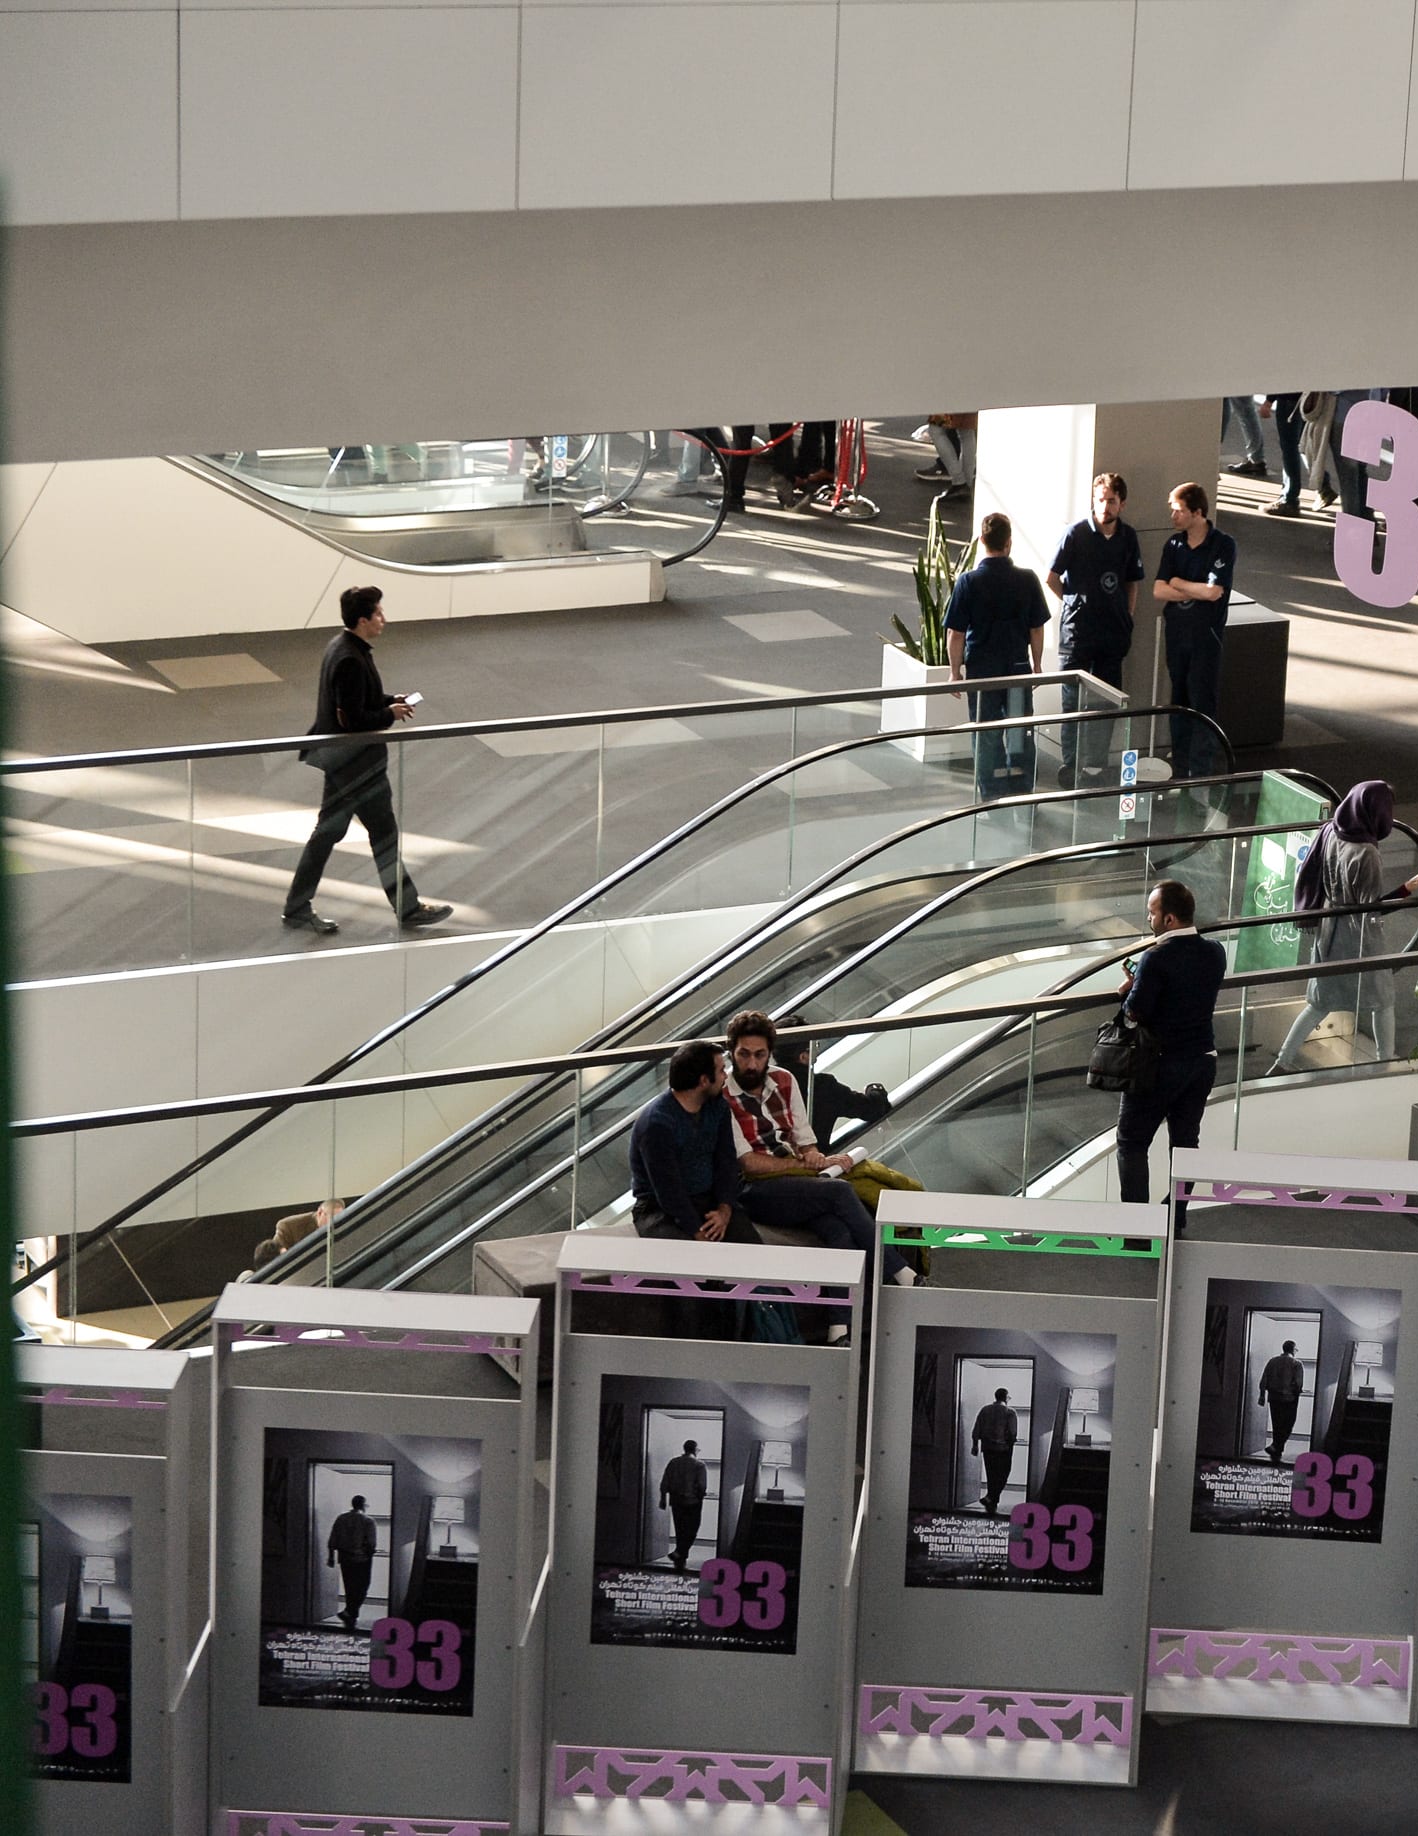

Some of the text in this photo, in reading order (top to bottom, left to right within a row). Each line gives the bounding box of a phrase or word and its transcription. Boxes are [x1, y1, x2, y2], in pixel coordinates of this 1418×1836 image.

[1205, 1481, 1292, 1494] Tehran International
[1292, 1452, 1375, 1520] 33
[1214, 1490, 1291, 1502] Short Film Festival
[919, 1534, 1009, 1546] Tehran International
[1008, 1503, 1095, 1571] 33
[928, 1543, 1008, 1555] Short Film Festival
[605, 1590, 698, 1603] Tehran International
[699, 1558, 787, 1629] 33
[615, 1599, 698, 1612] Short Film Festival
[371, 1618, 461, 1690] 33
